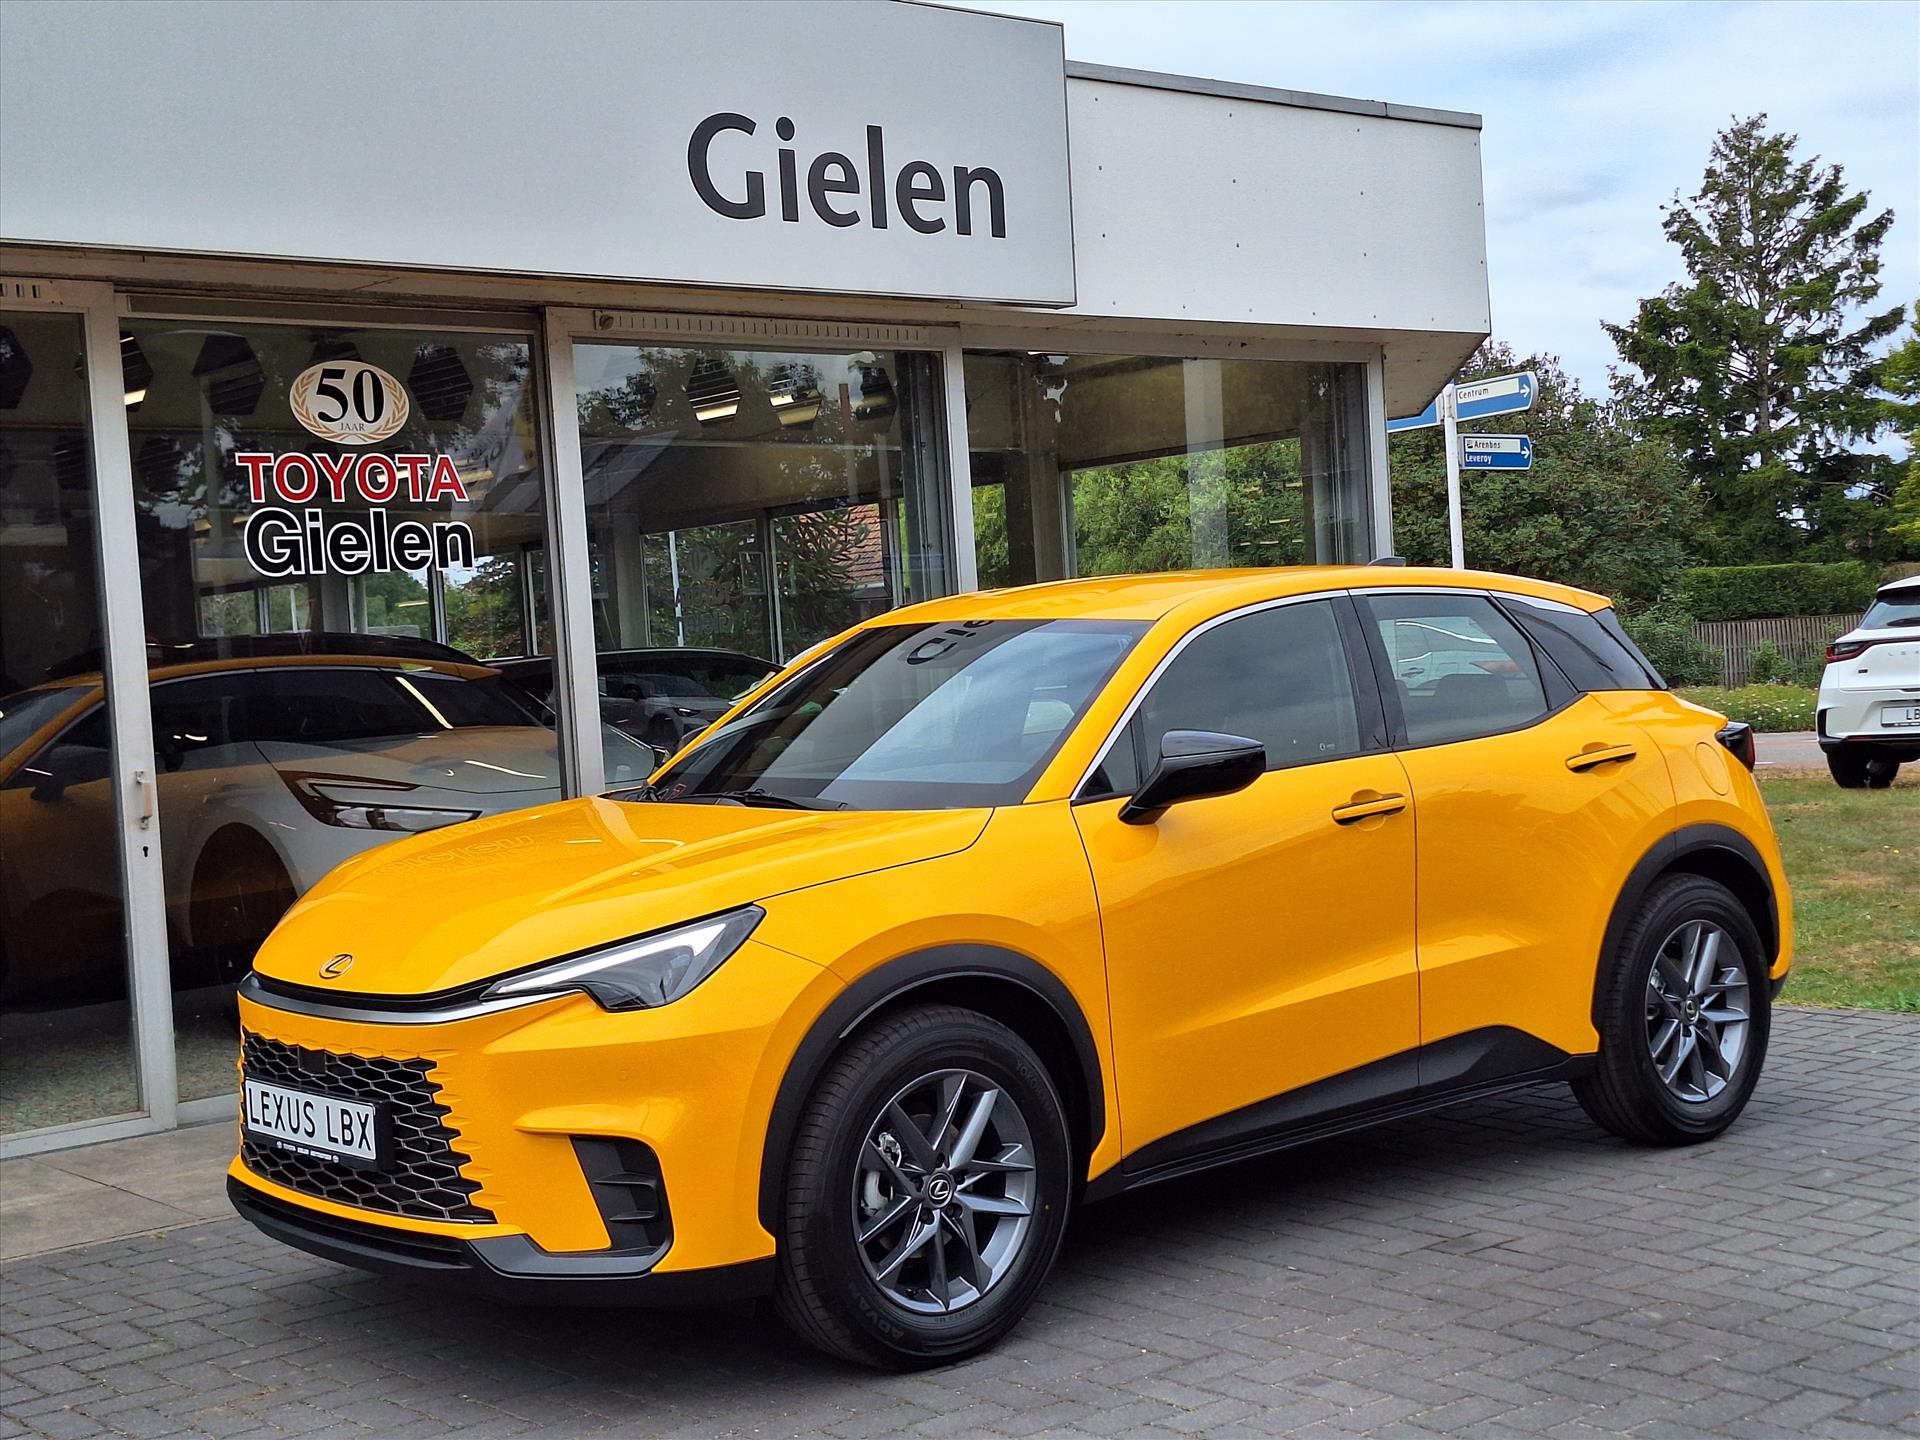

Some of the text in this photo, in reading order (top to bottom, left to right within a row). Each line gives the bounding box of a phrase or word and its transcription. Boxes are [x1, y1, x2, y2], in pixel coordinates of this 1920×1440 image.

[687, 112, 1006, 238] Gielen
[315, 368, 385, 424] 50
[1458, 388, 1489, 400] Centrum
[340, 422, 366, 432] JAAR
[235, 452, 469, 503] TOYOTA
[1465, 453, 1492, 465] Leveroy
[244, 507, 475, 577] Gielen
[249, 1087, 372, 1151] LEXUS LBX
